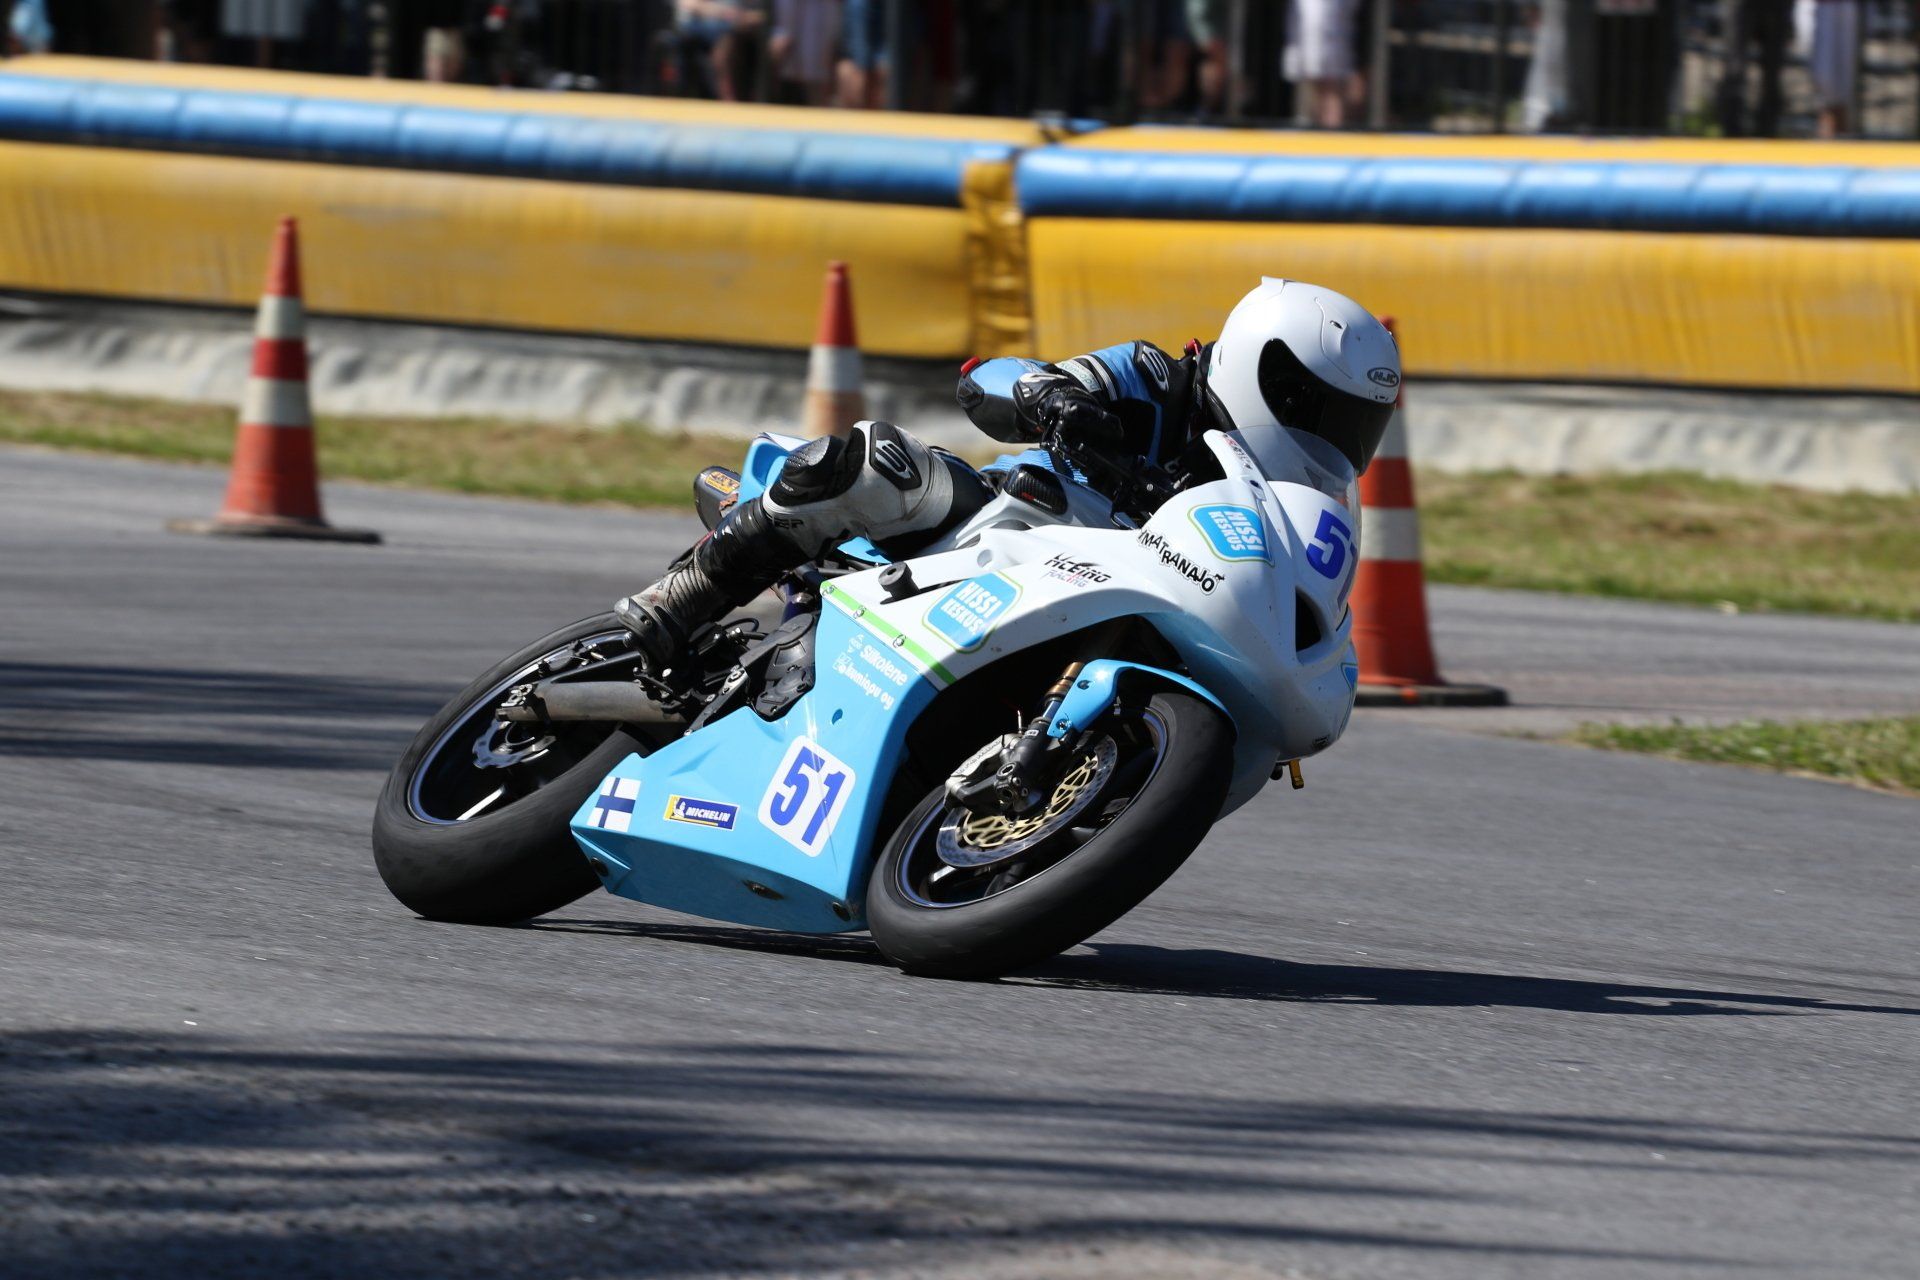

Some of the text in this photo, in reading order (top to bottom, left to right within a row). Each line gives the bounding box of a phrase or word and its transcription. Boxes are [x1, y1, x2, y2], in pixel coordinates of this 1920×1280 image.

[1374, 370, 1397, 385] HJC
[1208, 511, 1246, 551] KESKUS
[1224, 511, 1266, 551] HISSI
[1138, 529, 1215, 592] IMATRANAJO
[940, 598, 984, 635] KESKUS
[955, 581, 1003, 618] HISSI
[860, 645, 908, 686] Silkolene
[686, 806, 731, 822] MICHELIN
[770, 746, 846, 846] 51
